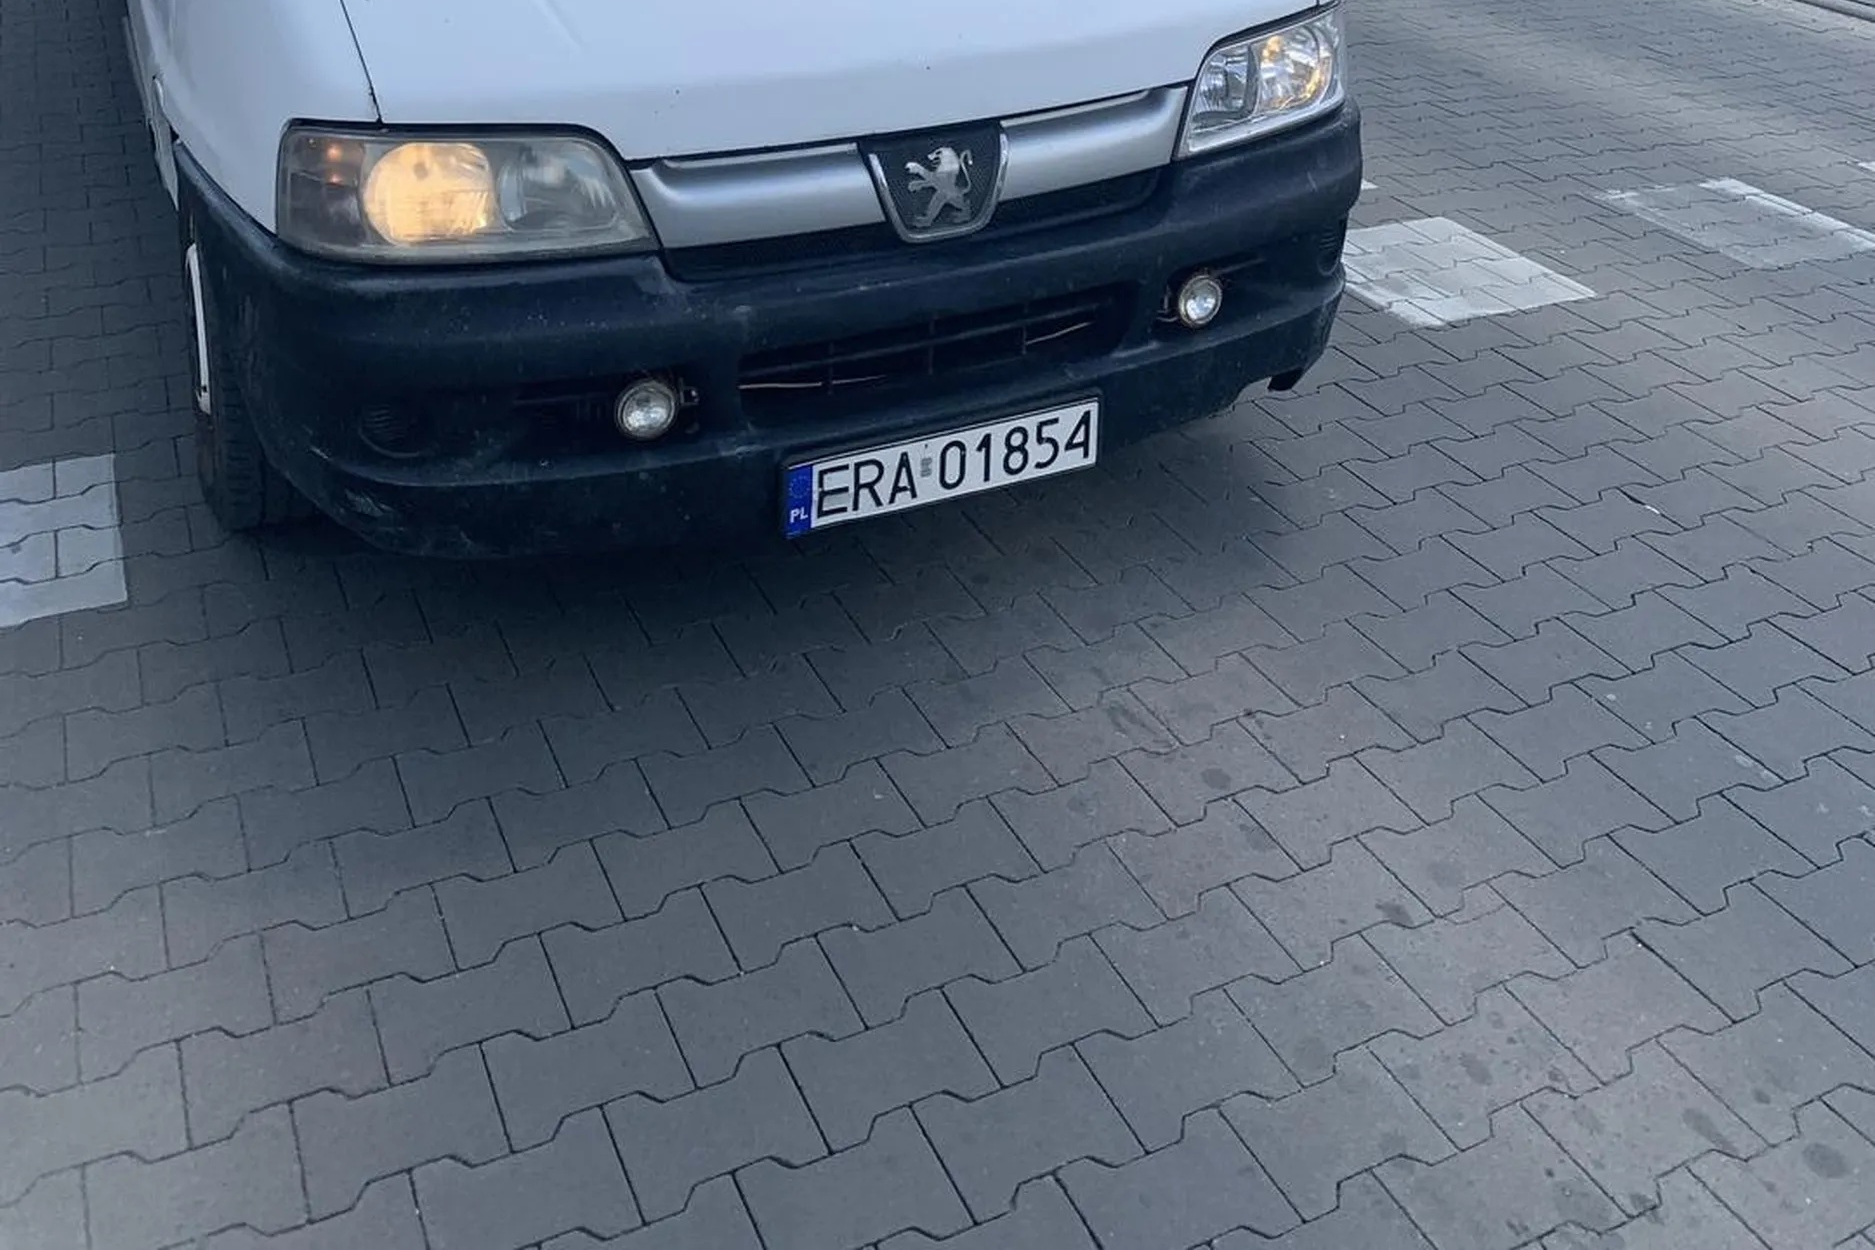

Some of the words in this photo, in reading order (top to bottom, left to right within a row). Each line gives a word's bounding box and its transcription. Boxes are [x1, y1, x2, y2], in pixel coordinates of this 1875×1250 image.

[816, 451, 918, 520] ERA
[938, 409, 1093, 491] 01854
[790, 507, 809, 524] PL
